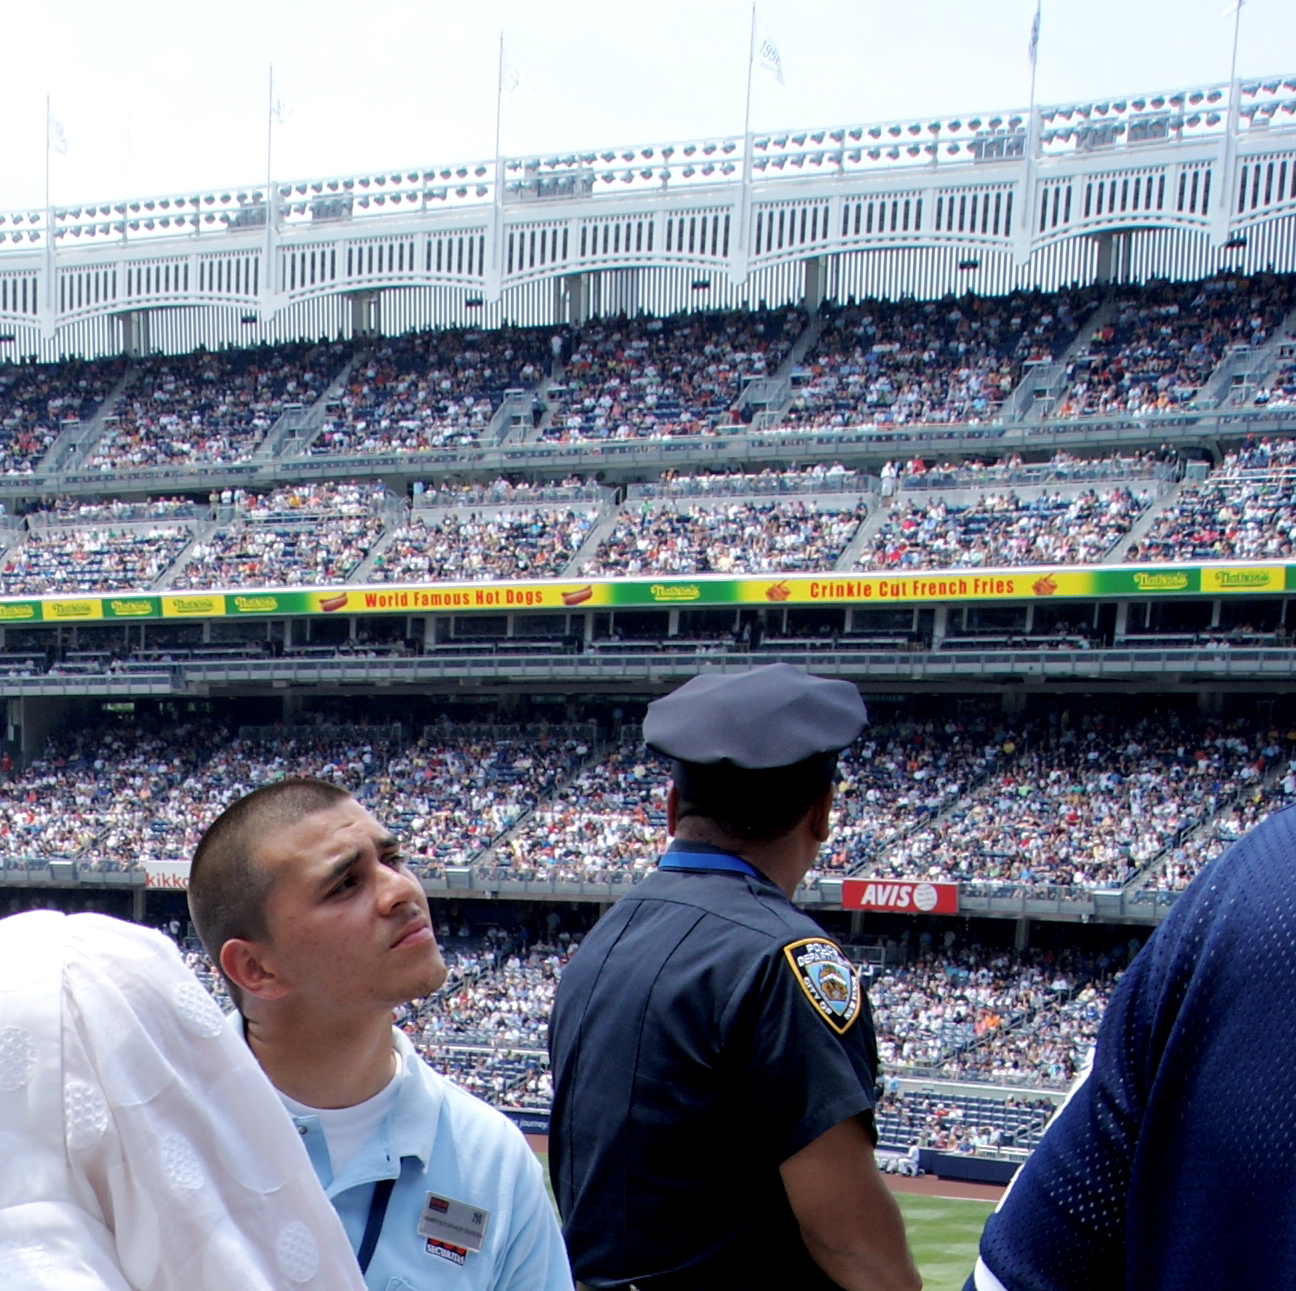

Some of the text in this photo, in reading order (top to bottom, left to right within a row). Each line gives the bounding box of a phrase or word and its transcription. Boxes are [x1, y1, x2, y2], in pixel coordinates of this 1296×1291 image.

[364, 588, 543, 608] World Famous Hot Dogs
[650, 584, 701, 601] Nathan's
[810, 578, 1015, 598] Crinkle Cut French Fries
[145, 872, 190, 889] kikko
[860, 883, 912, 908] AVIS
[427, 1243, 466, 1265] SECURITAS
